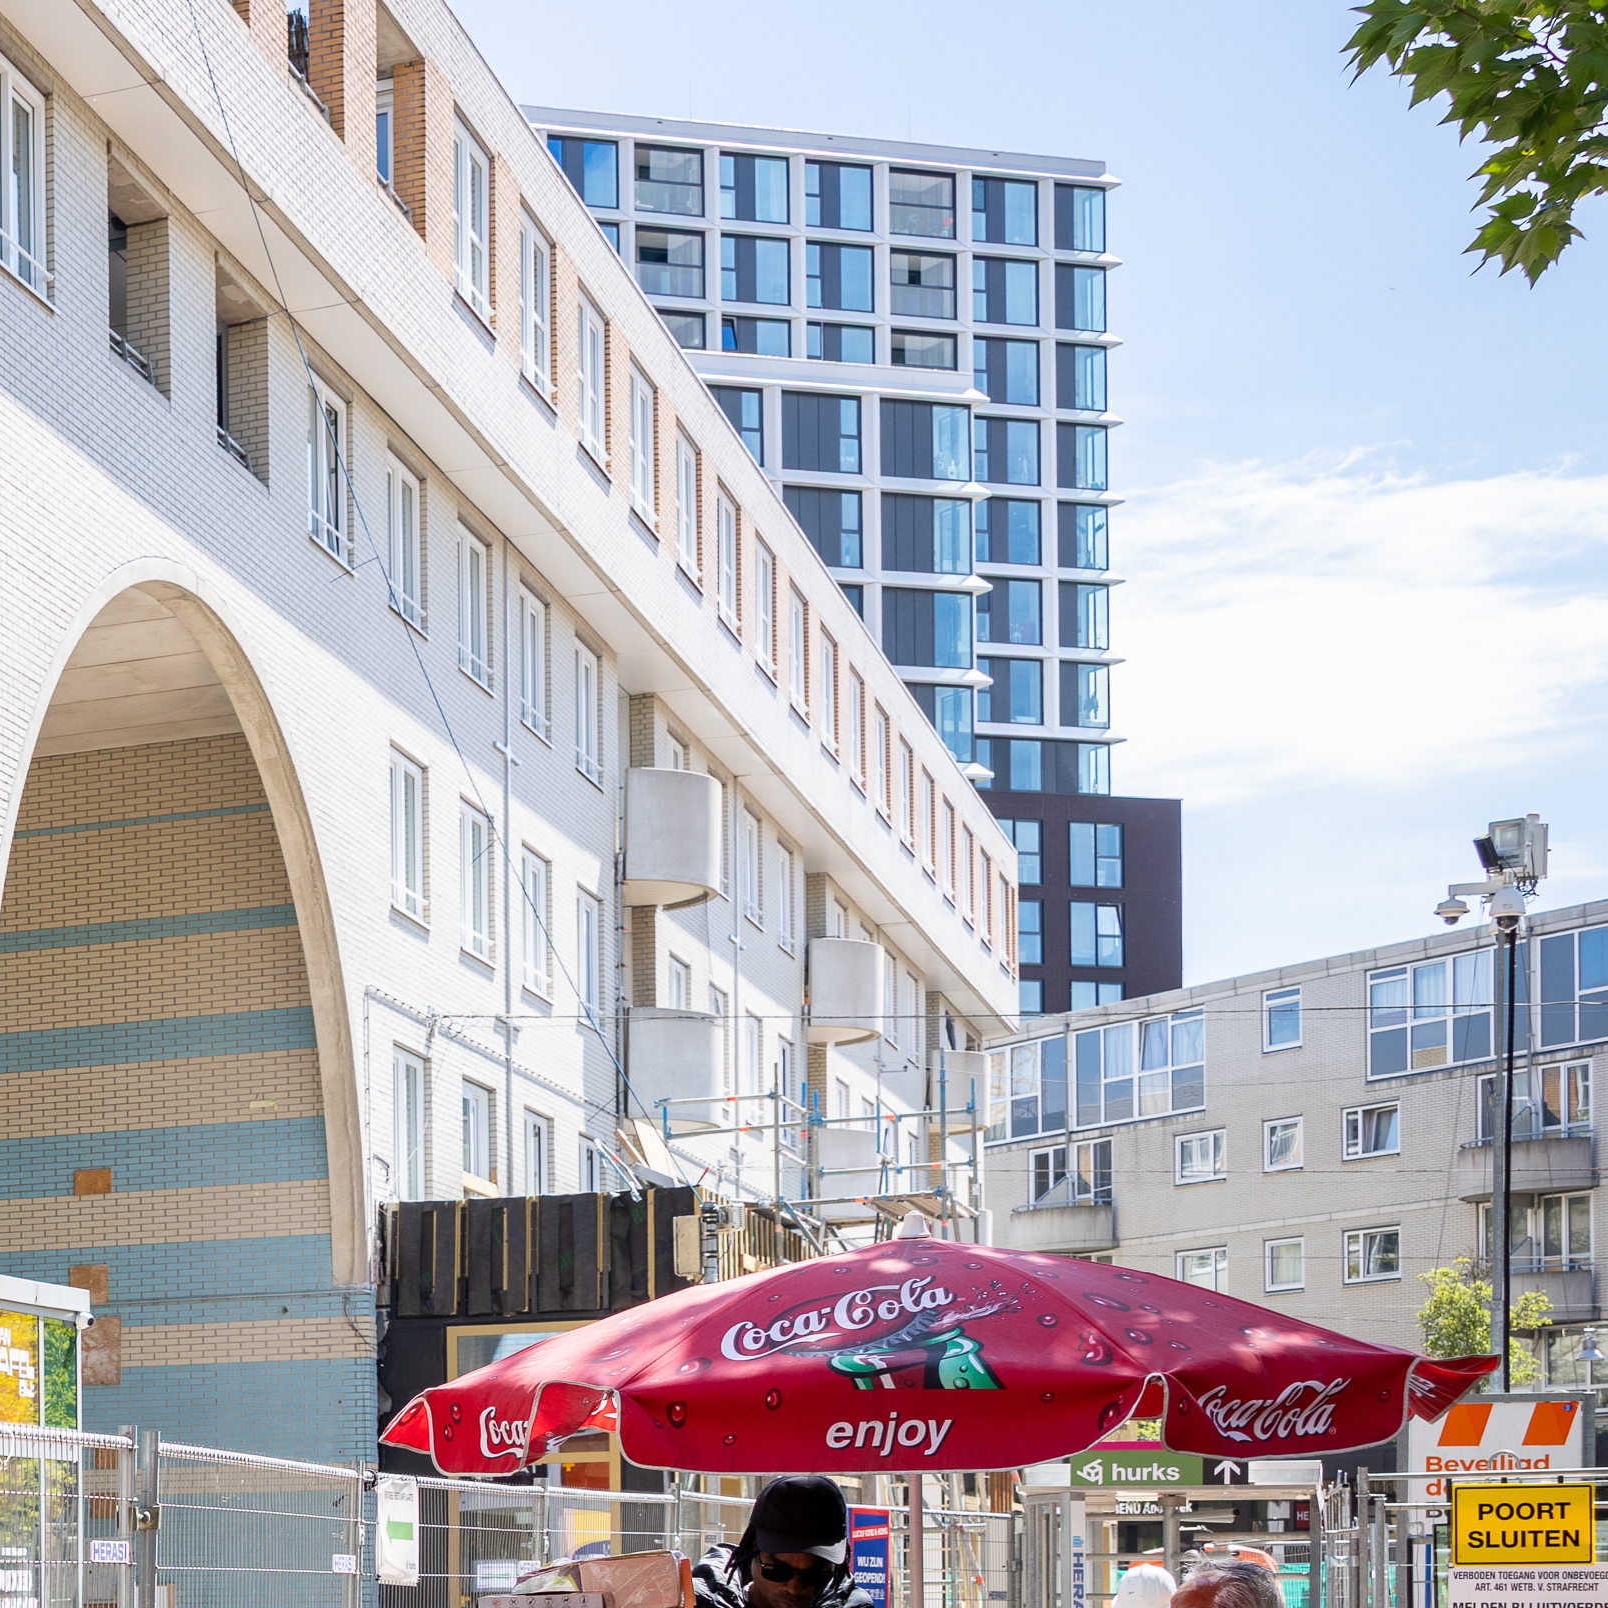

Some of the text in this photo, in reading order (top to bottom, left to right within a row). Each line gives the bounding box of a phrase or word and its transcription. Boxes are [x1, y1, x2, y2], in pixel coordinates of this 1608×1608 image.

[721, 1276, 954, 1360] Coca-Cola
[1197, 1378, 1351, 1441] Coca-Cola
[826, 1412, 953, 1456] enjoy
[1112, 1463, 1180, 1481] hurks
[1478, 1502, 1571, 1520] POORT
[1467, 1530, 1580, 1548] SLUITEN
[93, 1543, 124, 1562] HERAS
[854, 1572, 885, 1584] GEOPEND!
[1453, 1571, 1495, 1579] VERBODEN
[1499, 1571, 1535, 1579] TOEGANG
[1538, 1571, 1559, 1579] VOOR
[1475, 1583, 1599, 1591] ART. 461 WETB. V. STRAFRECHT
